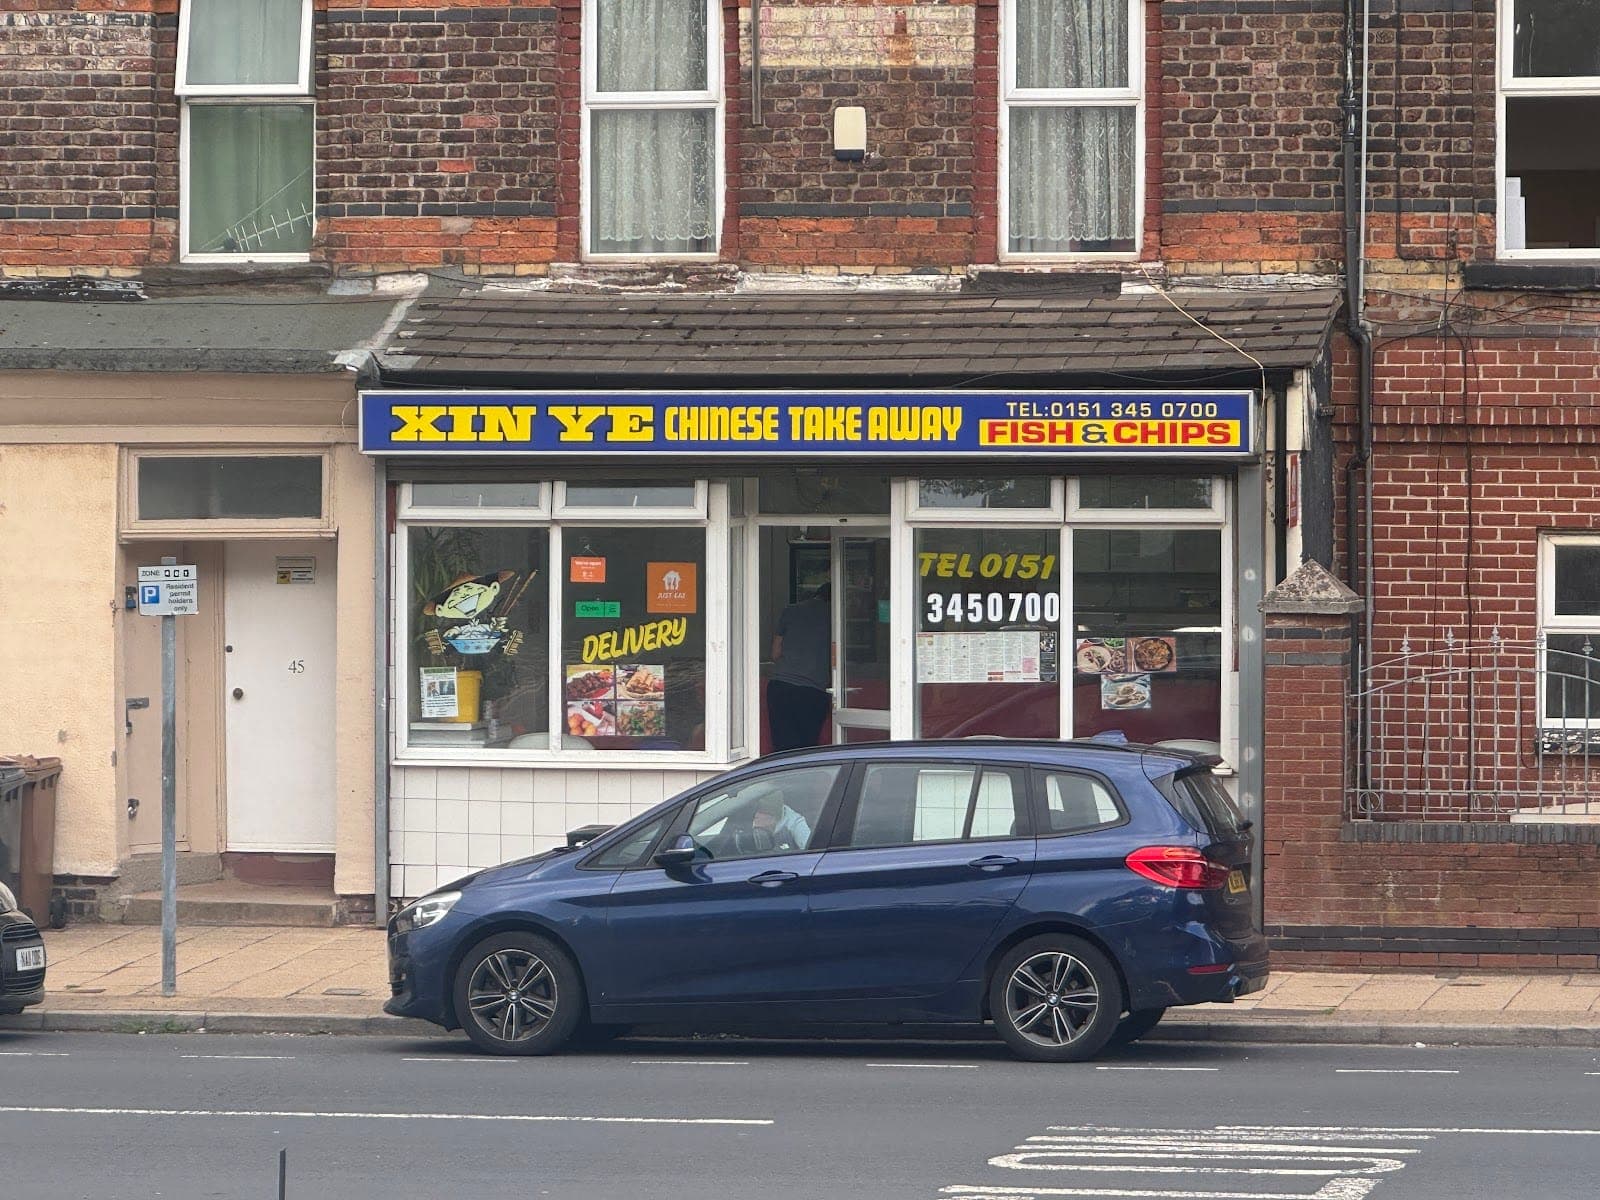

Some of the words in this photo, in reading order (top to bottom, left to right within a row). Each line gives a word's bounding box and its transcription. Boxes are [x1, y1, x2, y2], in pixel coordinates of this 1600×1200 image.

[1006, 401, 1101, 418] TEL:0151
[1110, 402, 1152, 418] 345
[1161, 402, 1219, 418] 0700
[390, 405, 537, 442] XIN
[547, 405, 655, 442] YE
[664, 406, 779, 441] CHINESE
[788, 406, 862, 441] TAKE
[868, 406, 963, 441] AWAY
[986, 421, 1074, 444] FISH
[1113, 421, 1232, 445] CHIPS
[918, 552, 974, 578] TEL
[980, 553, 1056, 579] 0151
[582, 616, 687, 664] DELIVERY
[288, 659, 305, 674] 45
